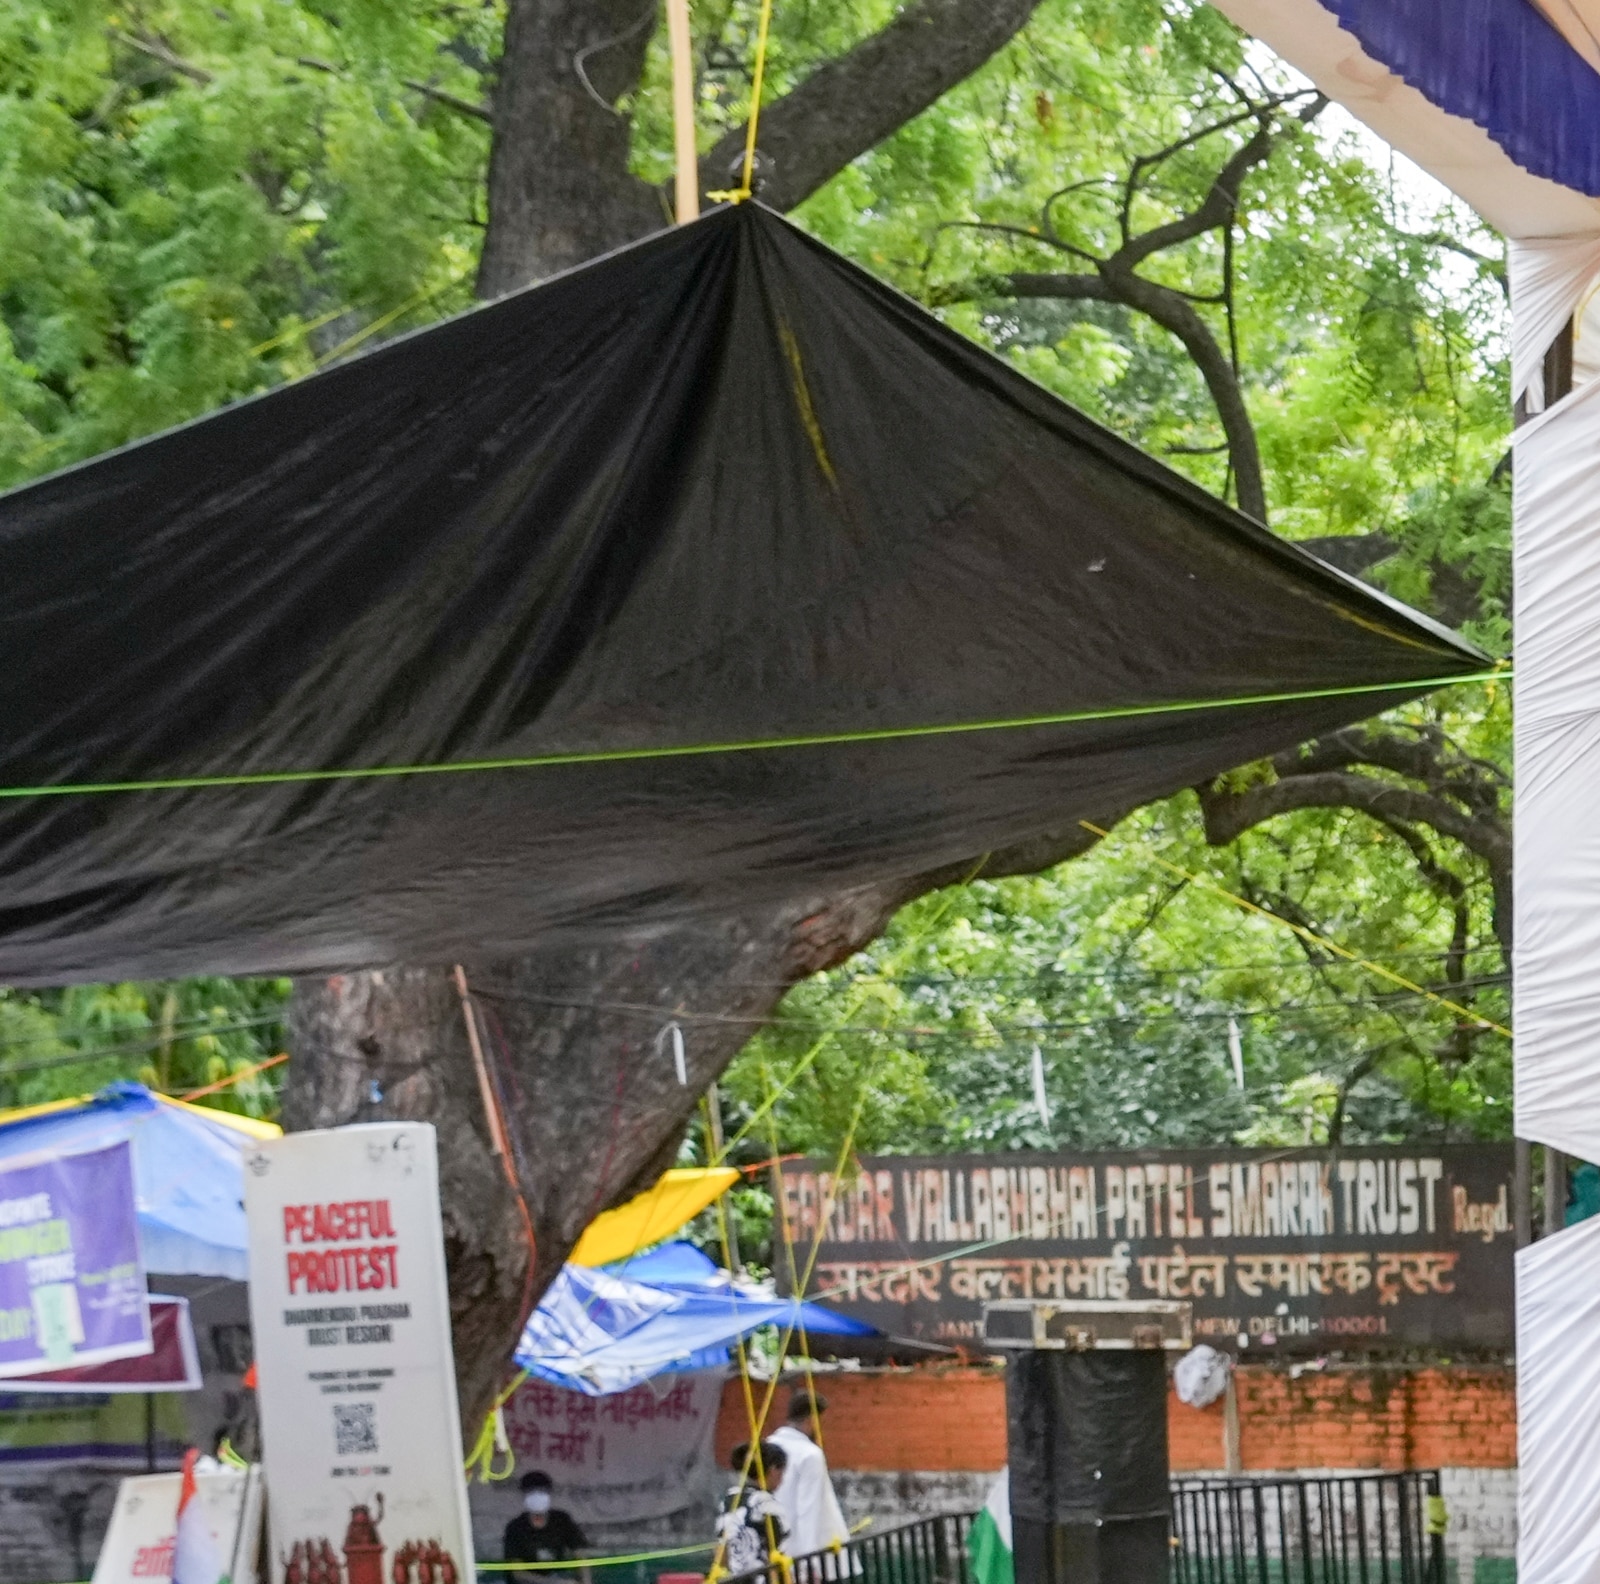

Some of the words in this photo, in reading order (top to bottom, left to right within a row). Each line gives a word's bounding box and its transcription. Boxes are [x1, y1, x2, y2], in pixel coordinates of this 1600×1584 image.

[284, 1200, 396, 1244] PEACEFUL
[902, 1166, 1098, 1242] VALLABHBHAI
[1106, 1162, 1204, 1239] PATEL
[1209, 1160, 1335, 1237] SMARAK
[1338, 1158, 1443, 1235] TRUST
[1453, 1184, 1514, 1243] Regd.
[287, 1245, 398, 1295] PROTEST
[816, 1258, 943, 1303] सरदार
[951, 1241, 1131, 1300] वल्लभभाई
[1137, 1245, 1229, 1298] पटेल
[1234, 1251, 1372, 1298] स्मारक
[1376, 1251, 1460, 1306] ट्रस्ट
[937, 1320, 986, 1338] JANT
